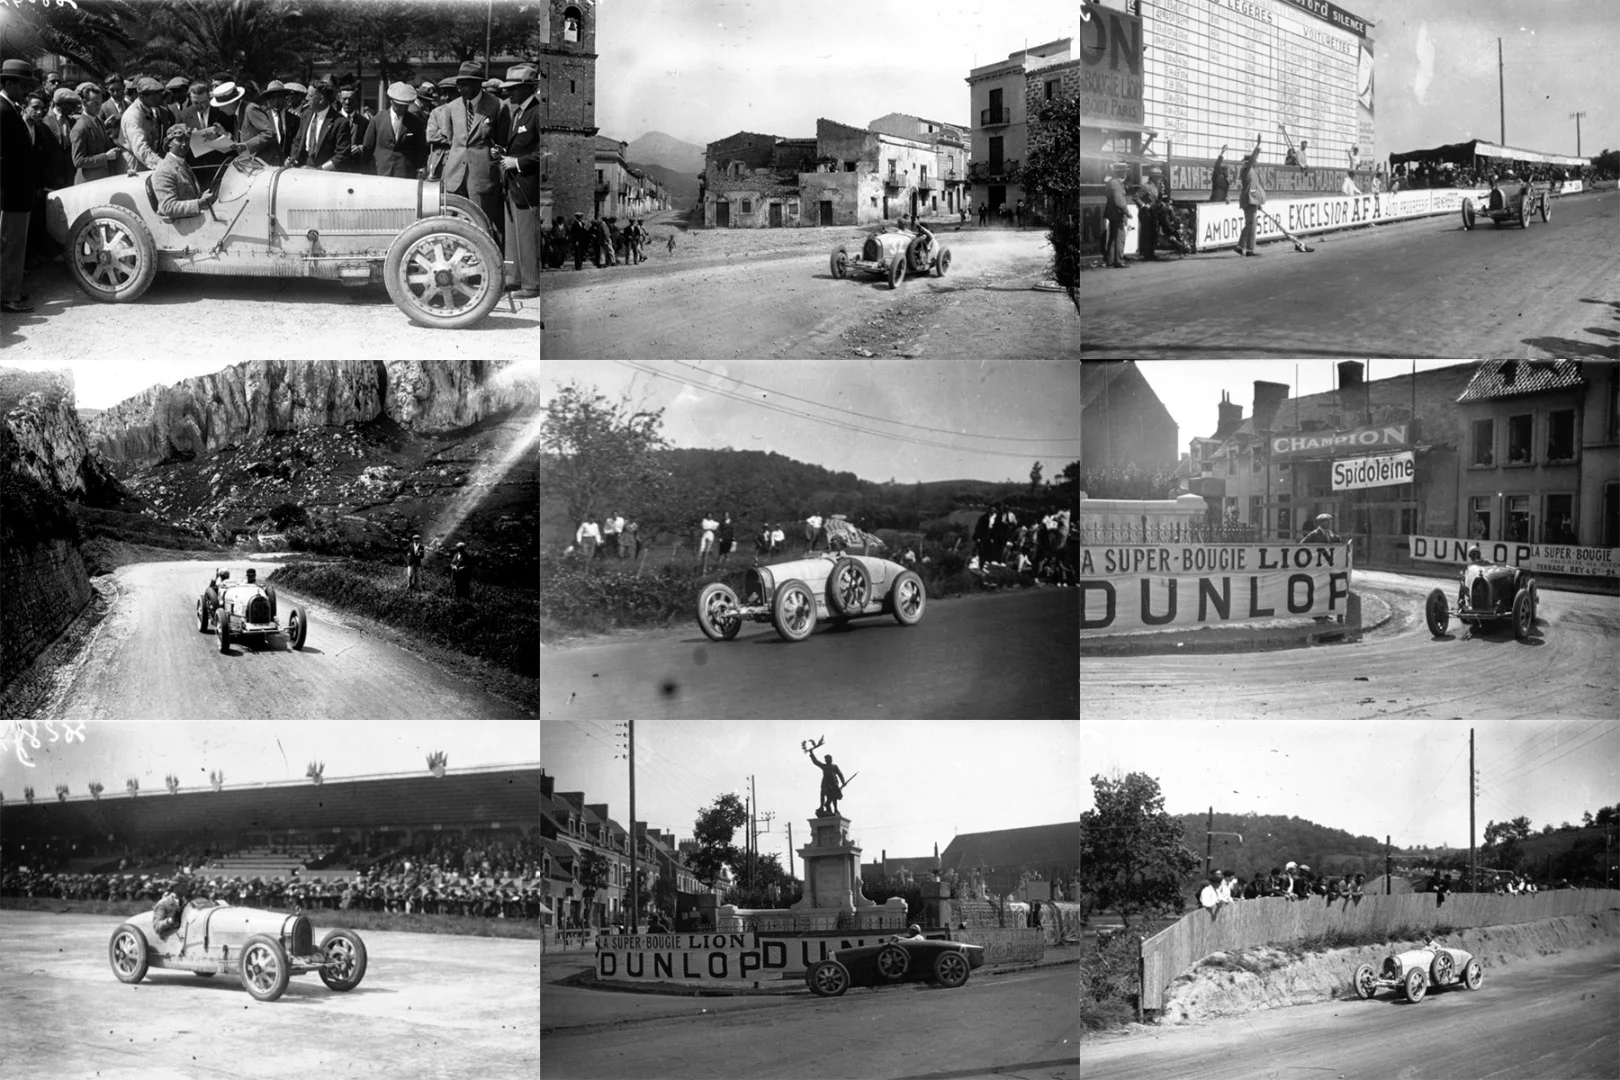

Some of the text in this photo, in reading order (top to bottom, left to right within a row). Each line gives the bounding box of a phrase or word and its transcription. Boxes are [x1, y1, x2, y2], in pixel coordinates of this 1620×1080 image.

[1333, 11, 1364, 33] SILENCE
[1303, 26, 1350, 54] VOITURETTES
[1111, 99, 1137, 118] PARIS
[1204, 213, 1283, 242] AMORTSEUR
[1289, 200, 1348, 231] EXCELSIOR
[1273, 425, 1409, 453] CHAMPION
[1105, 547, 1247, 573] SUPER-BOUGIE
[1258, 547, 1335, 569] LION
[1415, 537, 1531, 567] DUNOP
[1531, 546, 1612, 562] LA SUPER-BOUGIE
[612, 935, 681, 950] SUPER-BOUGIE
[689, 934, 745, 949] LION
[601, 951, 761, 979] DUNLOP
